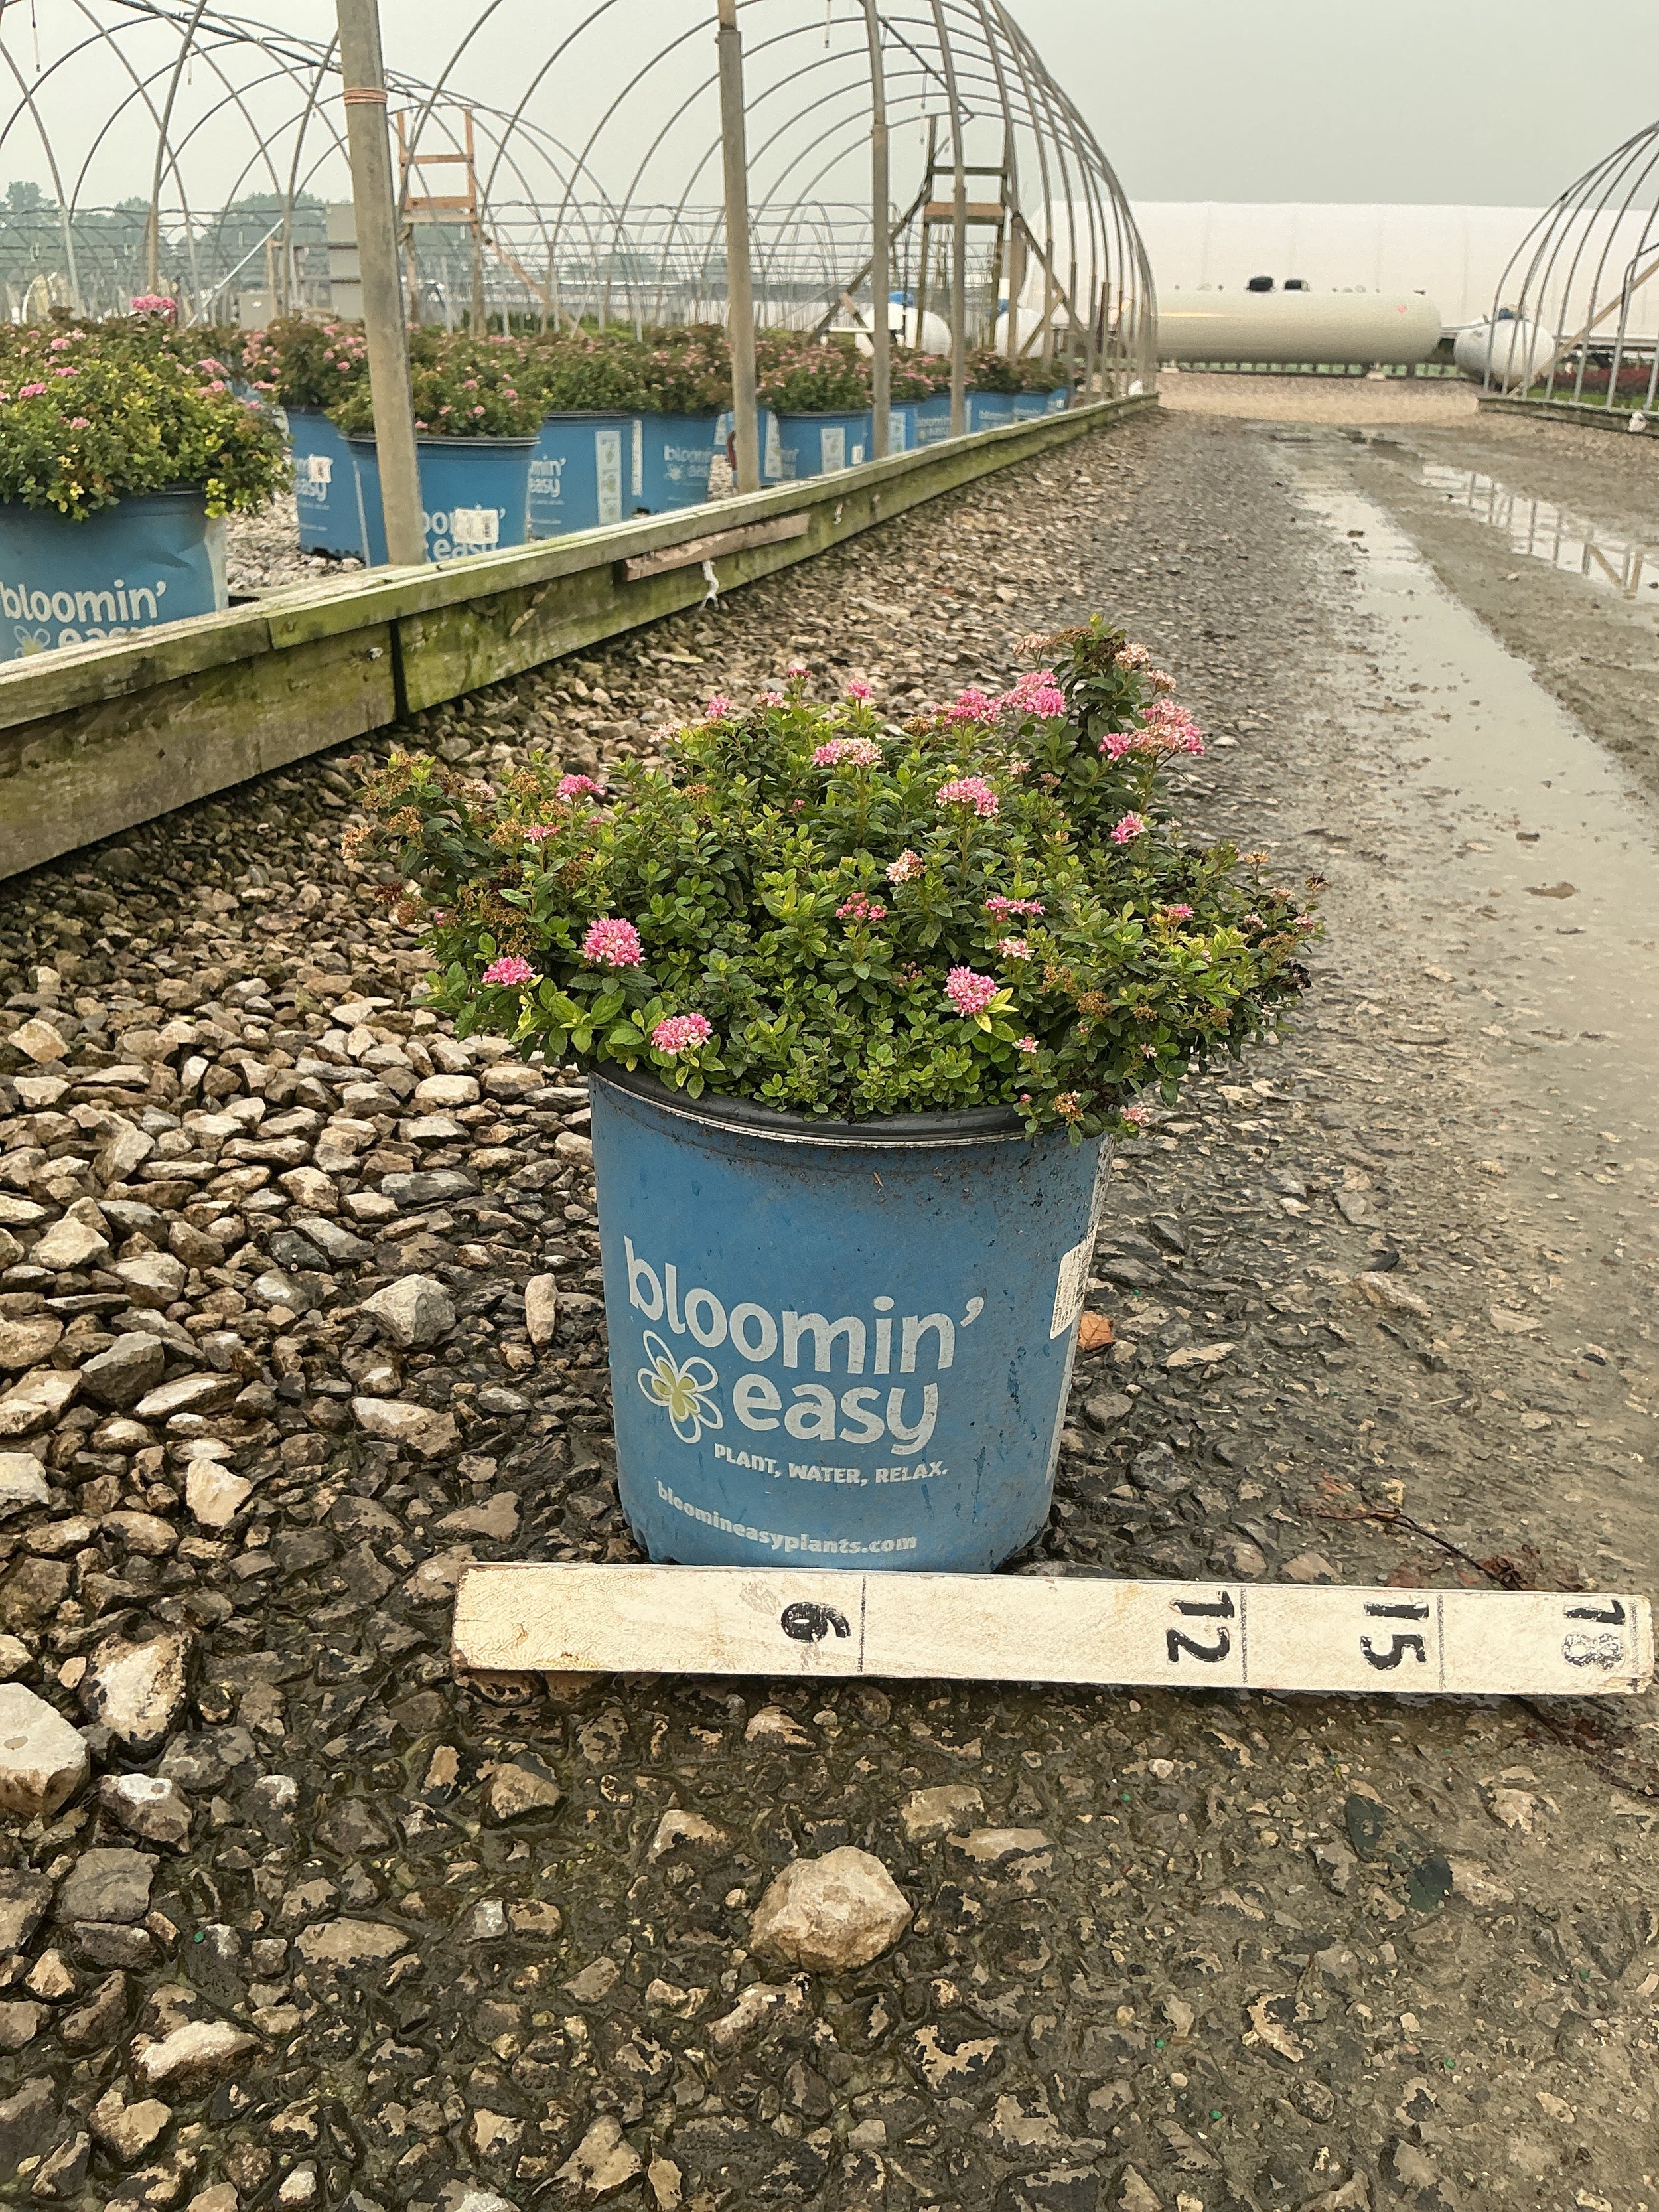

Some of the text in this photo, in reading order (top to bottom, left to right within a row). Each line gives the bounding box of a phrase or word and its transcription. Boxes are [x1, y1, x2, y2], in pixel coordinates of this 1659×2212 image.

[0, 579, 166, 623] bloomin'
[624, 1234, 985, 1375] bloomin'
[733, 1373, 938, 1455] easy
[715, 1443, 949, 1487] PLANT, WATER, RELAX.
[657, 1481, 917, 1554] bloomineasyplants.com
[780, 1601, 851, 1643] 6
[1167, 1591, 1235, 1664] 12
[1360, 1601, 1429, 1670] 15
[1563, 1599, 1626, 1671] 18
